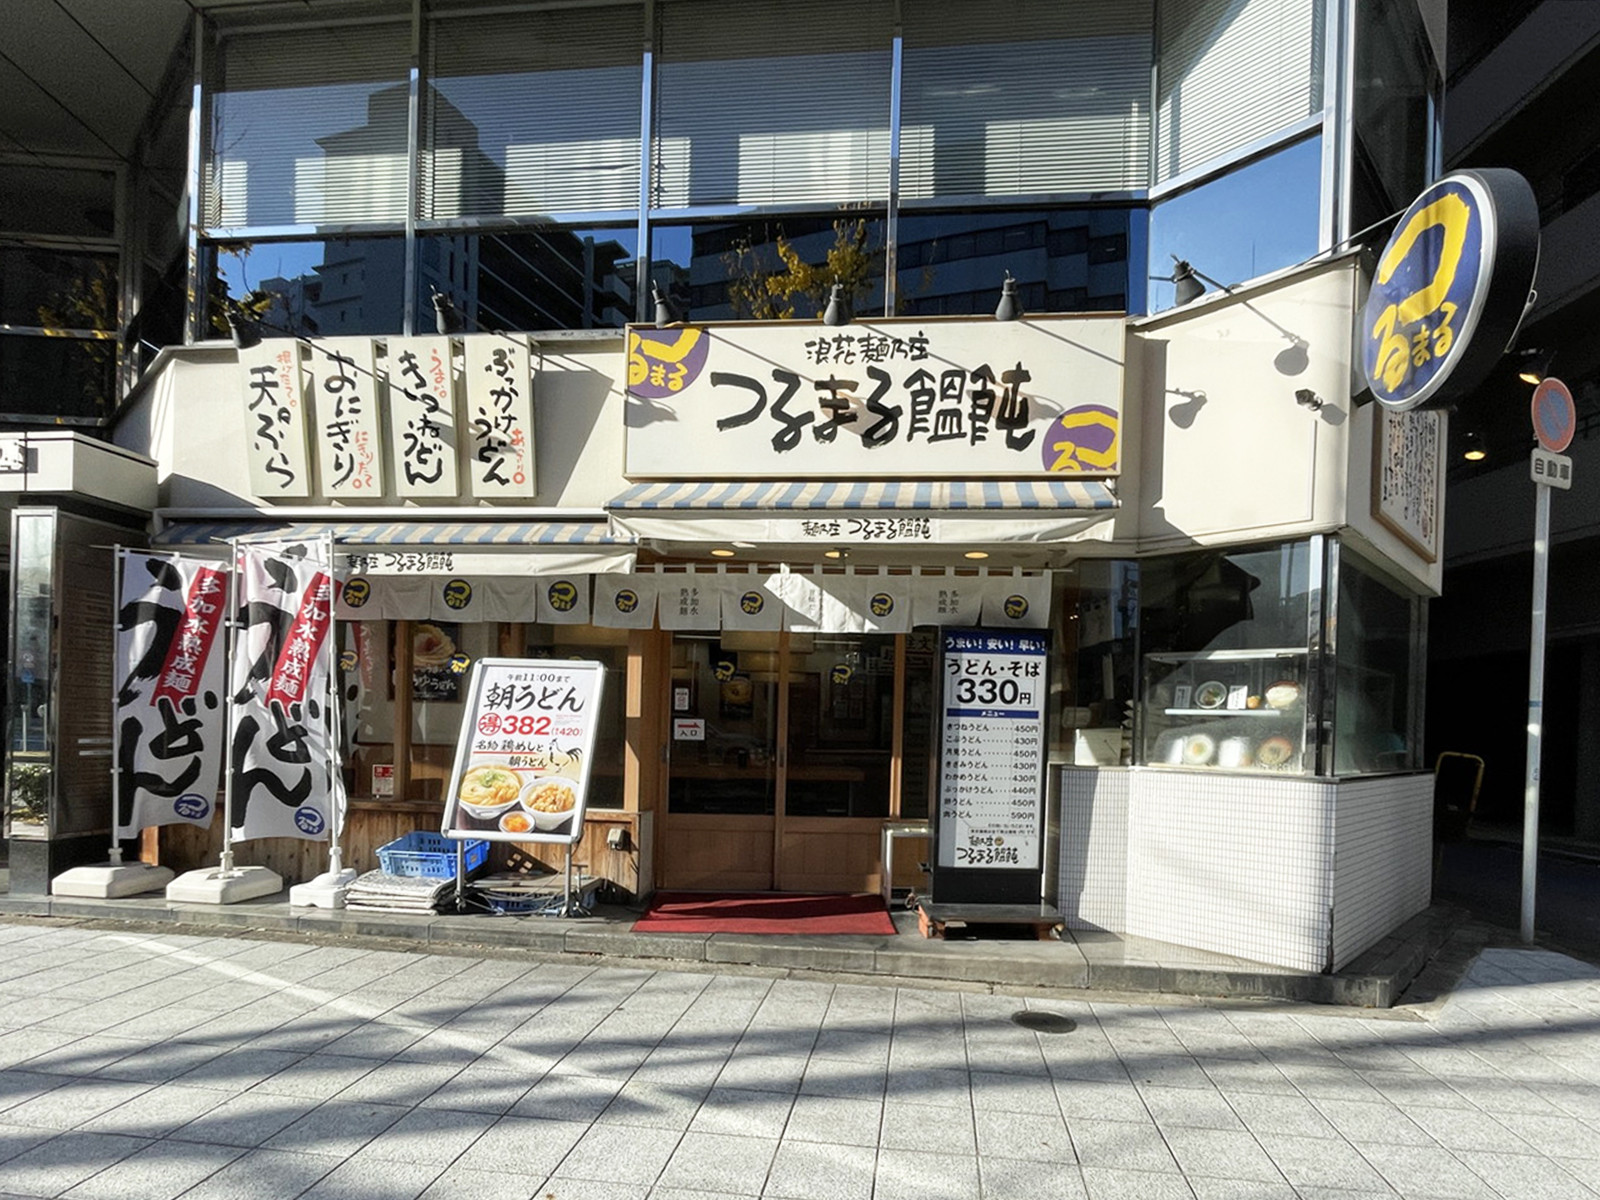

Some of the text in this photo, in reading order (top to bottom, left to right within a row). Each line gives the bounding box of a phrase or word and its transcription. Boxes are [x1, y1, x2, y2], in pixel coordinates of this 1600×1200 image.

[1374, 192, 1470, 393] つるまる
[248, 365, 296, 489] 天ぷら
[323, 350, 362, 490] おにぎり
[398, 350, 443, 486] きつねうどん
[474, 347, 519, 486] ぶっかけうどん
[1534, 457, 1570, 481] 自動車
[483, 682, 586, 713] 朝うどん
[947, 659, 1042, 678] うどん・そば
[956, 678, 1031, 705] 330円
[502, 715, 551, 736] 382
